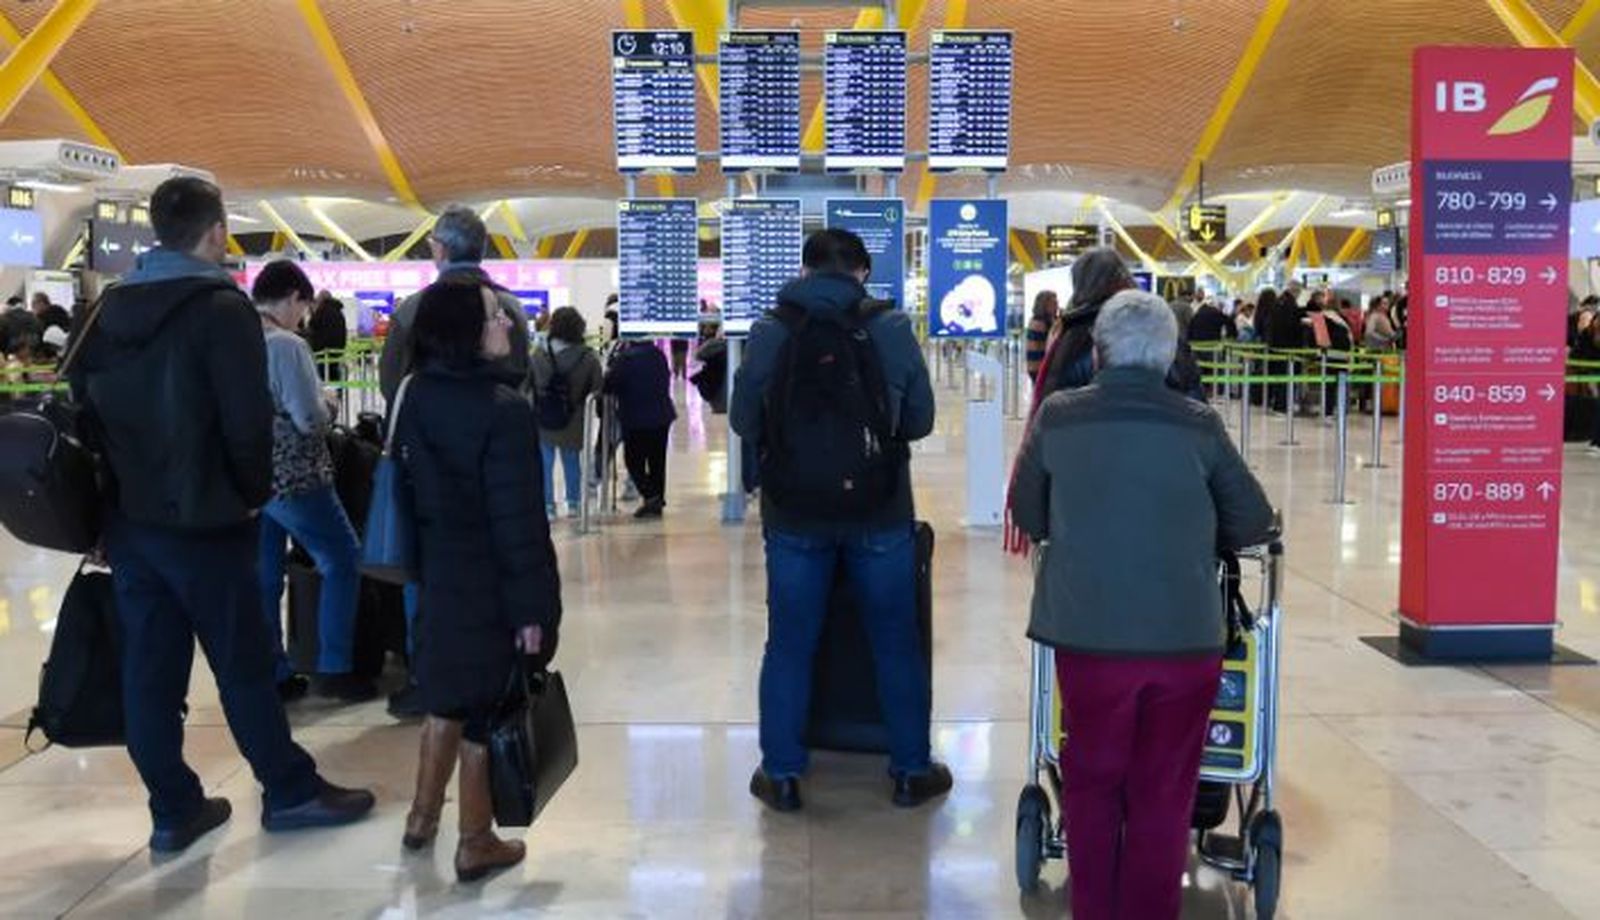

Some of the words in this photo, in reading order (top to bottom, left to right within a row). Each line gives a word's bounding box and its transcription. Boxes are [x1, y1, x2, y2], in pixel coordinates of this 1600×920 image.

[651, 43, 685, 55] 12:10
[1435, 81, 1487, 112] IB
[1436, 191, 1527, 211] 780-799
[1435, 266, 1527, 285] 810-829
[1434, 385, 1526, 403] 840-859
[1433, 482, 1525, 501] 870-889
